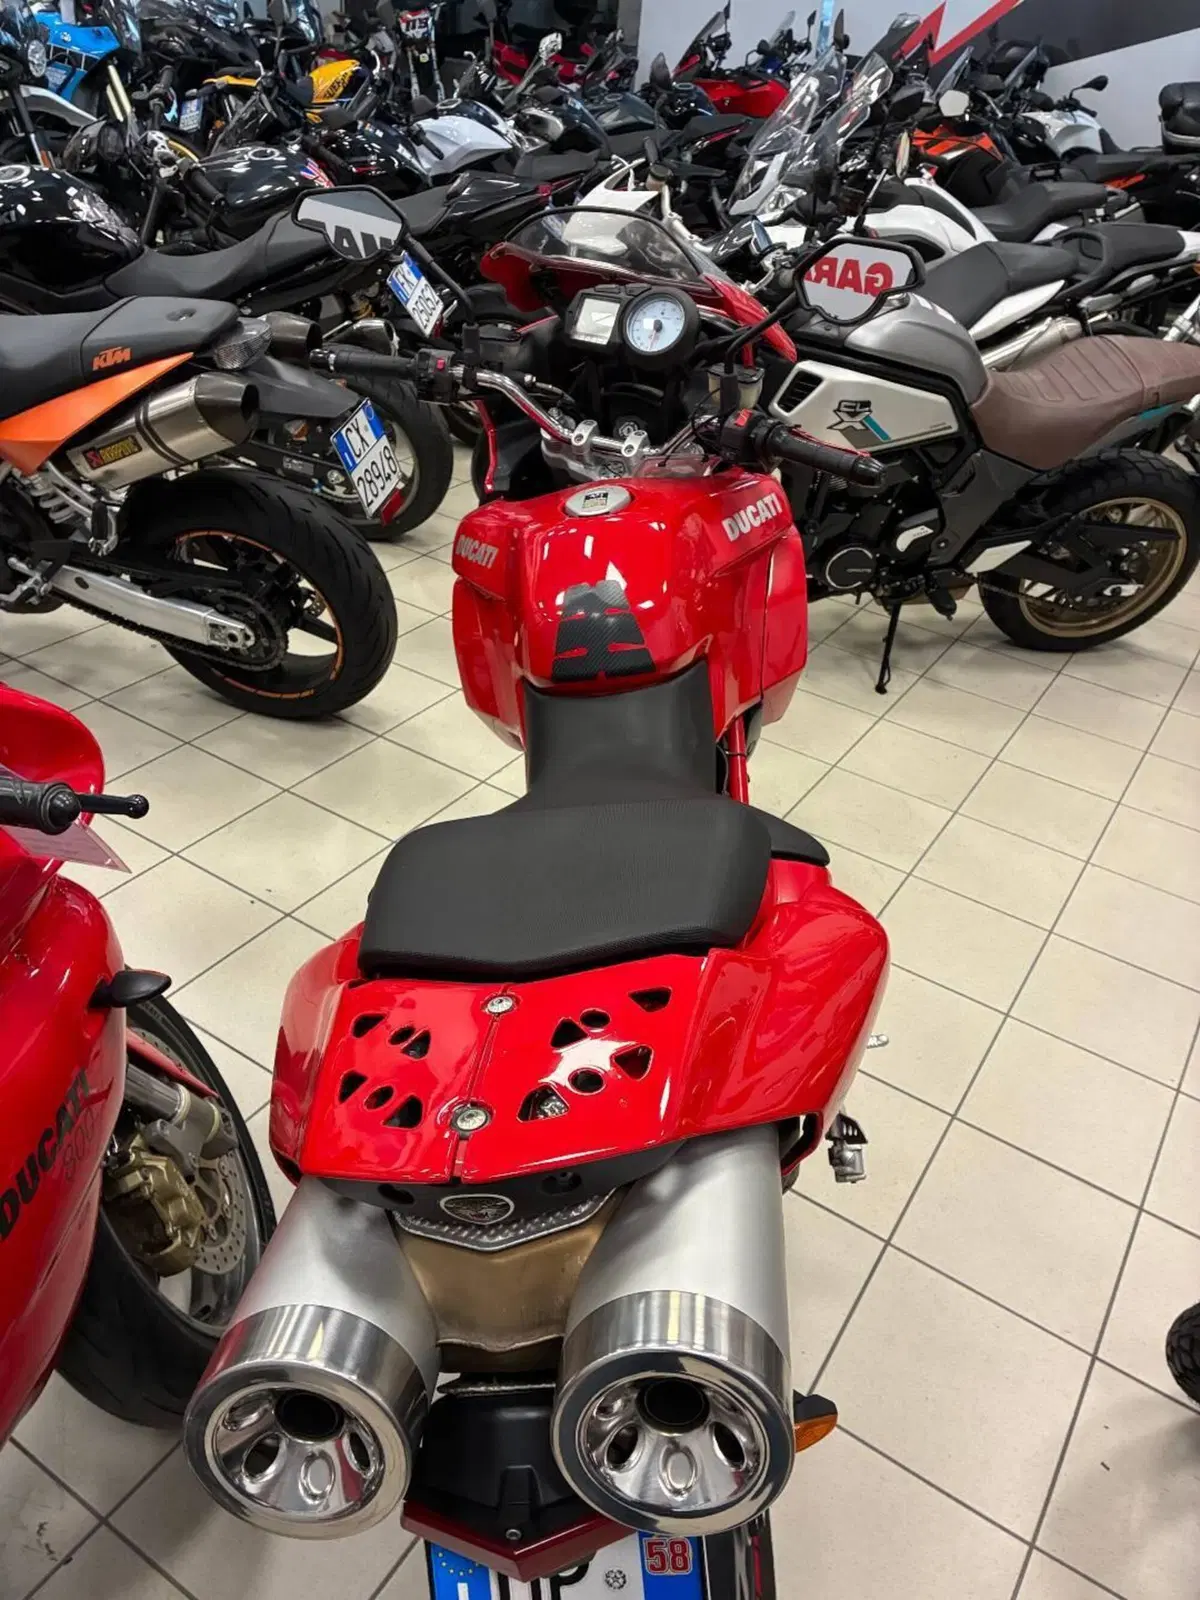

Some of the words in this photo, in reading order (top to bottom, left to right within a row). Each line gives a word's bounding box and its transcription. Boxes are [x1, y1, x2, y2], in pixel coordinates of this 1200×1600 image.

[92, 346, 131, 371] KTM
[345, 417, 370, 458] CX
[357, 445, 398, 507] 28948
[720, 492, 783, 543] DUCATI
[455, 533, 500, 570] DUCATI
[0, 1066, 90, 1242] DUCATI
[643, 1536, 693, 1576] 58
